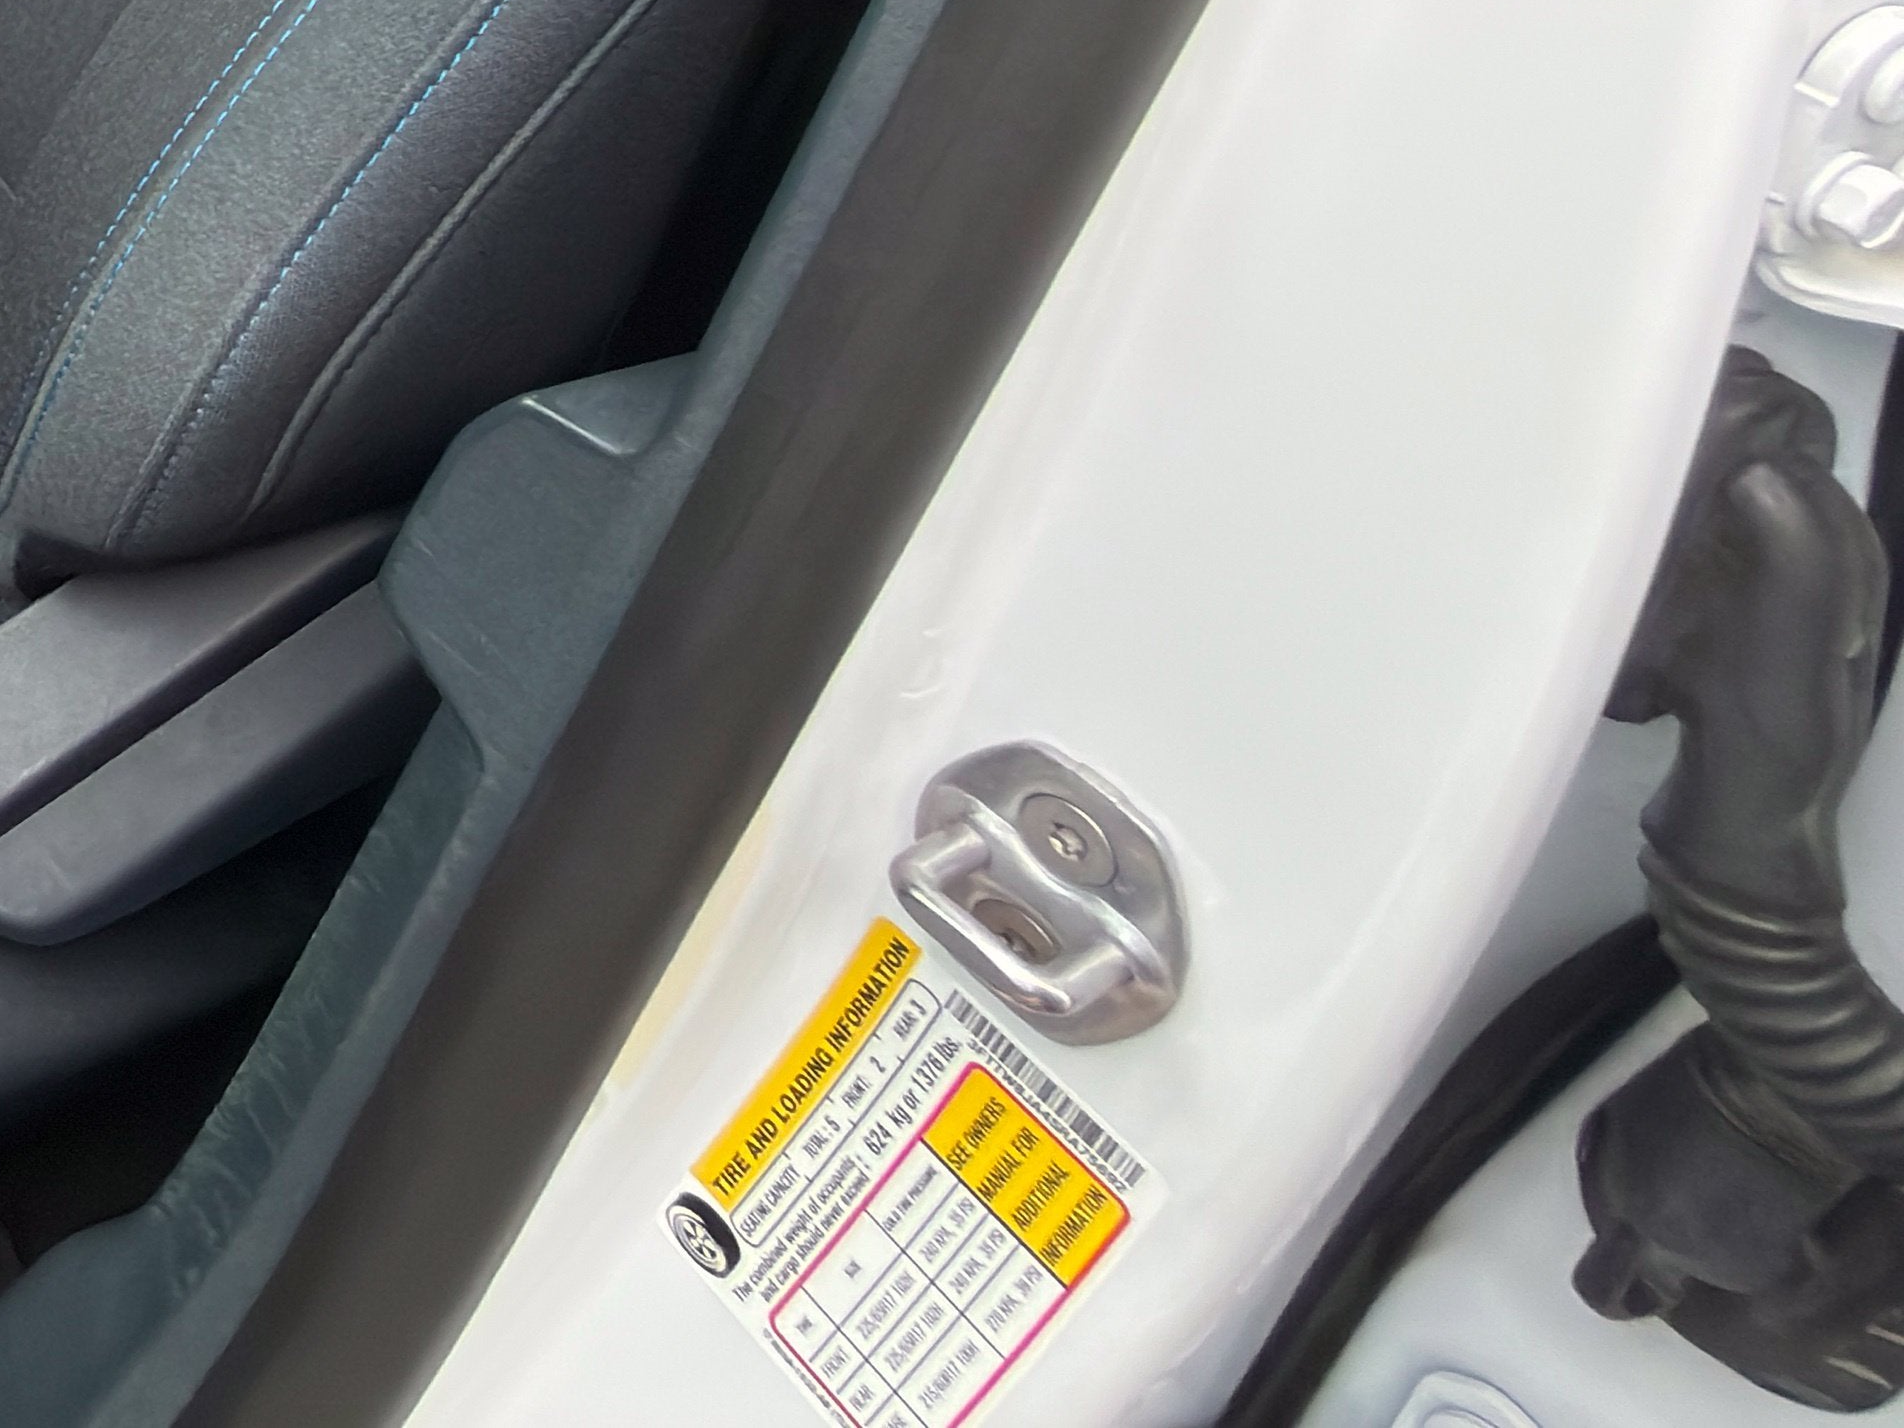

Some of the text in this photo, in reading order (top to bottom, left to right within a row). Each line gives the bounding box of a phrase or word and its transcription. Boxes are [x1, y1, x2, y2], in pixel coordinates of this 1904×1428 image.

[712, 937, 908, 1195] TIRE AND LOADING INFORMATION
[902, 1088, 920, 1110] or
[910, 1052, 945, 1092] 1376
[740, 1200, 771, 1237] SEATING
[764, 1164, 799, 1206] CAPACITY
[824, 1115, 840, 1132] 5
[869, 1055, 886, 1073] 2
[909, 998, 926, 1015] 3
[863, 1121, 892, 1155] 624
[884, 1104, 912, 1128] kg
[946, 1096, 1005, 1170] SEE OWNERS
[976, 1126, 1039, 1202] MANUAL FOR
[1012, 1162, 1069, 1231] ADDITIONAL
[731, 1156, 857, 1302] The combined weight of occupants
[759, 1167, 870, 1302] and cargo should never exceed
[1039, 1185, 1106, 1265] INFORMATION
